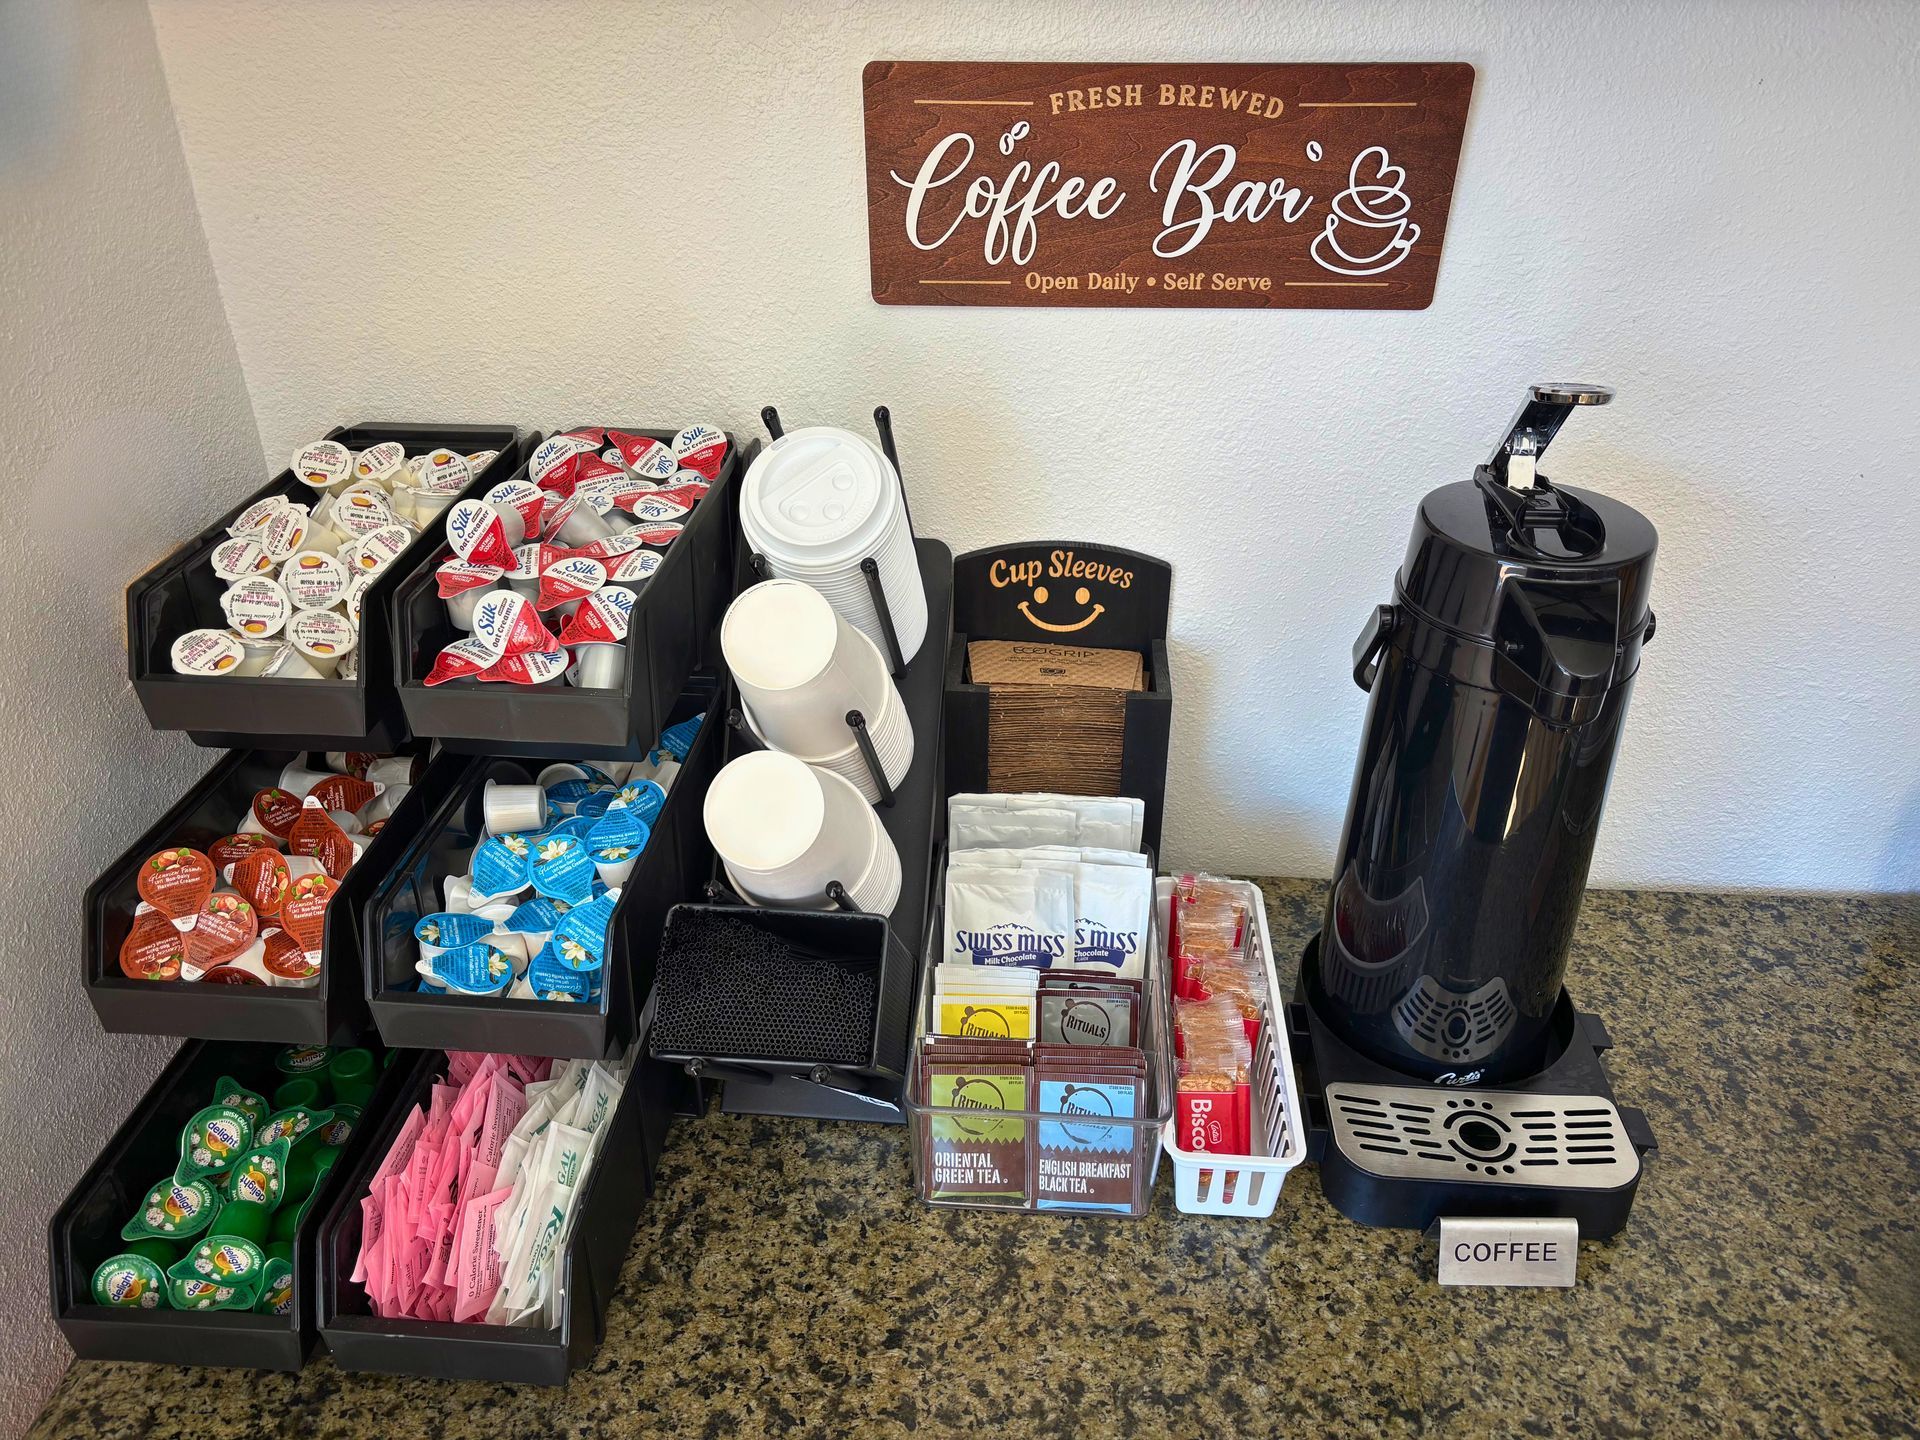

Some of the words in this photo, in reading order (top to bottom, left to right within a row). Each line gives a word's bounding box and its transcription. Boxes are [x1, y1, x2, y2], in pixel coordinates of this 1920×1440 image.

[1050, 83, 1143, 116] FRESH
[1158, 83, 1285, 120] BREWED
[890, 132, 1126, 266] Coffee
[1149, 139, 1313, 258] Bar
[1025, 272, 1082, 293] Open
[1088, 273, 1140, 294] Daily
[1163, 273, 1206, 292] Self
[1212, 274, 1272, 292] Serve
[682, 427, 707, 446] Silk
[537, 442, 559, 466] Silk
[694, 449, 713, 458] OATMEAL
[535, 466, 545, 476] Oat
[550, 464, 567, 478] OATMEAL
[655, 455, 673, 474] Silk
[492, 485, 520, 503] Silk
[504, 491, 536, 504] reamer
[641, 505, 668, 517] Silk
[452, 507, 472, 538] Silk
[460, 537, 470, 551] Oat
[479, 533, 494, 551] OATMEAL
[483, 536, 496, 552] COOKIE
[552, 568, 565, 576] Oat
[566, 561, 598, 575] Silk
[638, 555, 658, 572] Silk
[990, 559, 1042, 587] Cup
[1049, 550, 1133, 588] Sleeves
[554, 581, 574, 591] OATMEAL
[595, 593, 604, 605] Oat
[607, 592, 633, 615] Silk
[478, 603, 497, 635] Silk
[588, 611, 602, 629] OATMEAL
[493, 632, 502, 648] Oat
[512, 620, 524, 642] OATMEAL
[149, 869, 180, 884] Glenview
[181, 865, 202, 874] Farms
[166, 874, 190, 882] Non-Dairy
[157, 881, 180, 890] Hazelnut
[287, 901, 313, 912] Glenview
[984, 957, 1001, 965] Milk
[1001, 953, 1037, 963] Chocolate
[1066, 1015, 1106, 1038] RITUALS
[1434, 1071, 1480, 1086] Curtis
[958, 1095, 1000, 1110] RITU
[223, 1111, 238, 1119] IRISH
[207, 1122, 238, 1148] delight
[487, 1134, 496, 1163] Calorie
[492, 1092, 501, 1131] Sweetener
[1191, 1100, 1212, 1154] Bisco
[1211, 1124, 1219, 1141] Lotus
[558, 1150, 571, 1185] GAL
[935, 1152, 993, 1168] ORIENTAL
[1040, 1159, 1077, 1176] ENGLISH
[1079, 1162, 1131, 1178] BREAKFAST
[935, 1168, 974, 1184] GREEN
[1039, 1175, 1068, 1192] BLACK
[240, 1175, 265, 1202] delight
[172, 1187, 196, 1216] delight
[469, 1253, 477, 1289] Calorie
[475, 1211, 483, 1253] Sweetener
[527, 1205, 564, 1283] REGAL
[1455, 1243, 1557, 1262] COFFEE
[223, 1245, 244, 1273] delight
[112, 1271, 135, 1302] delight
